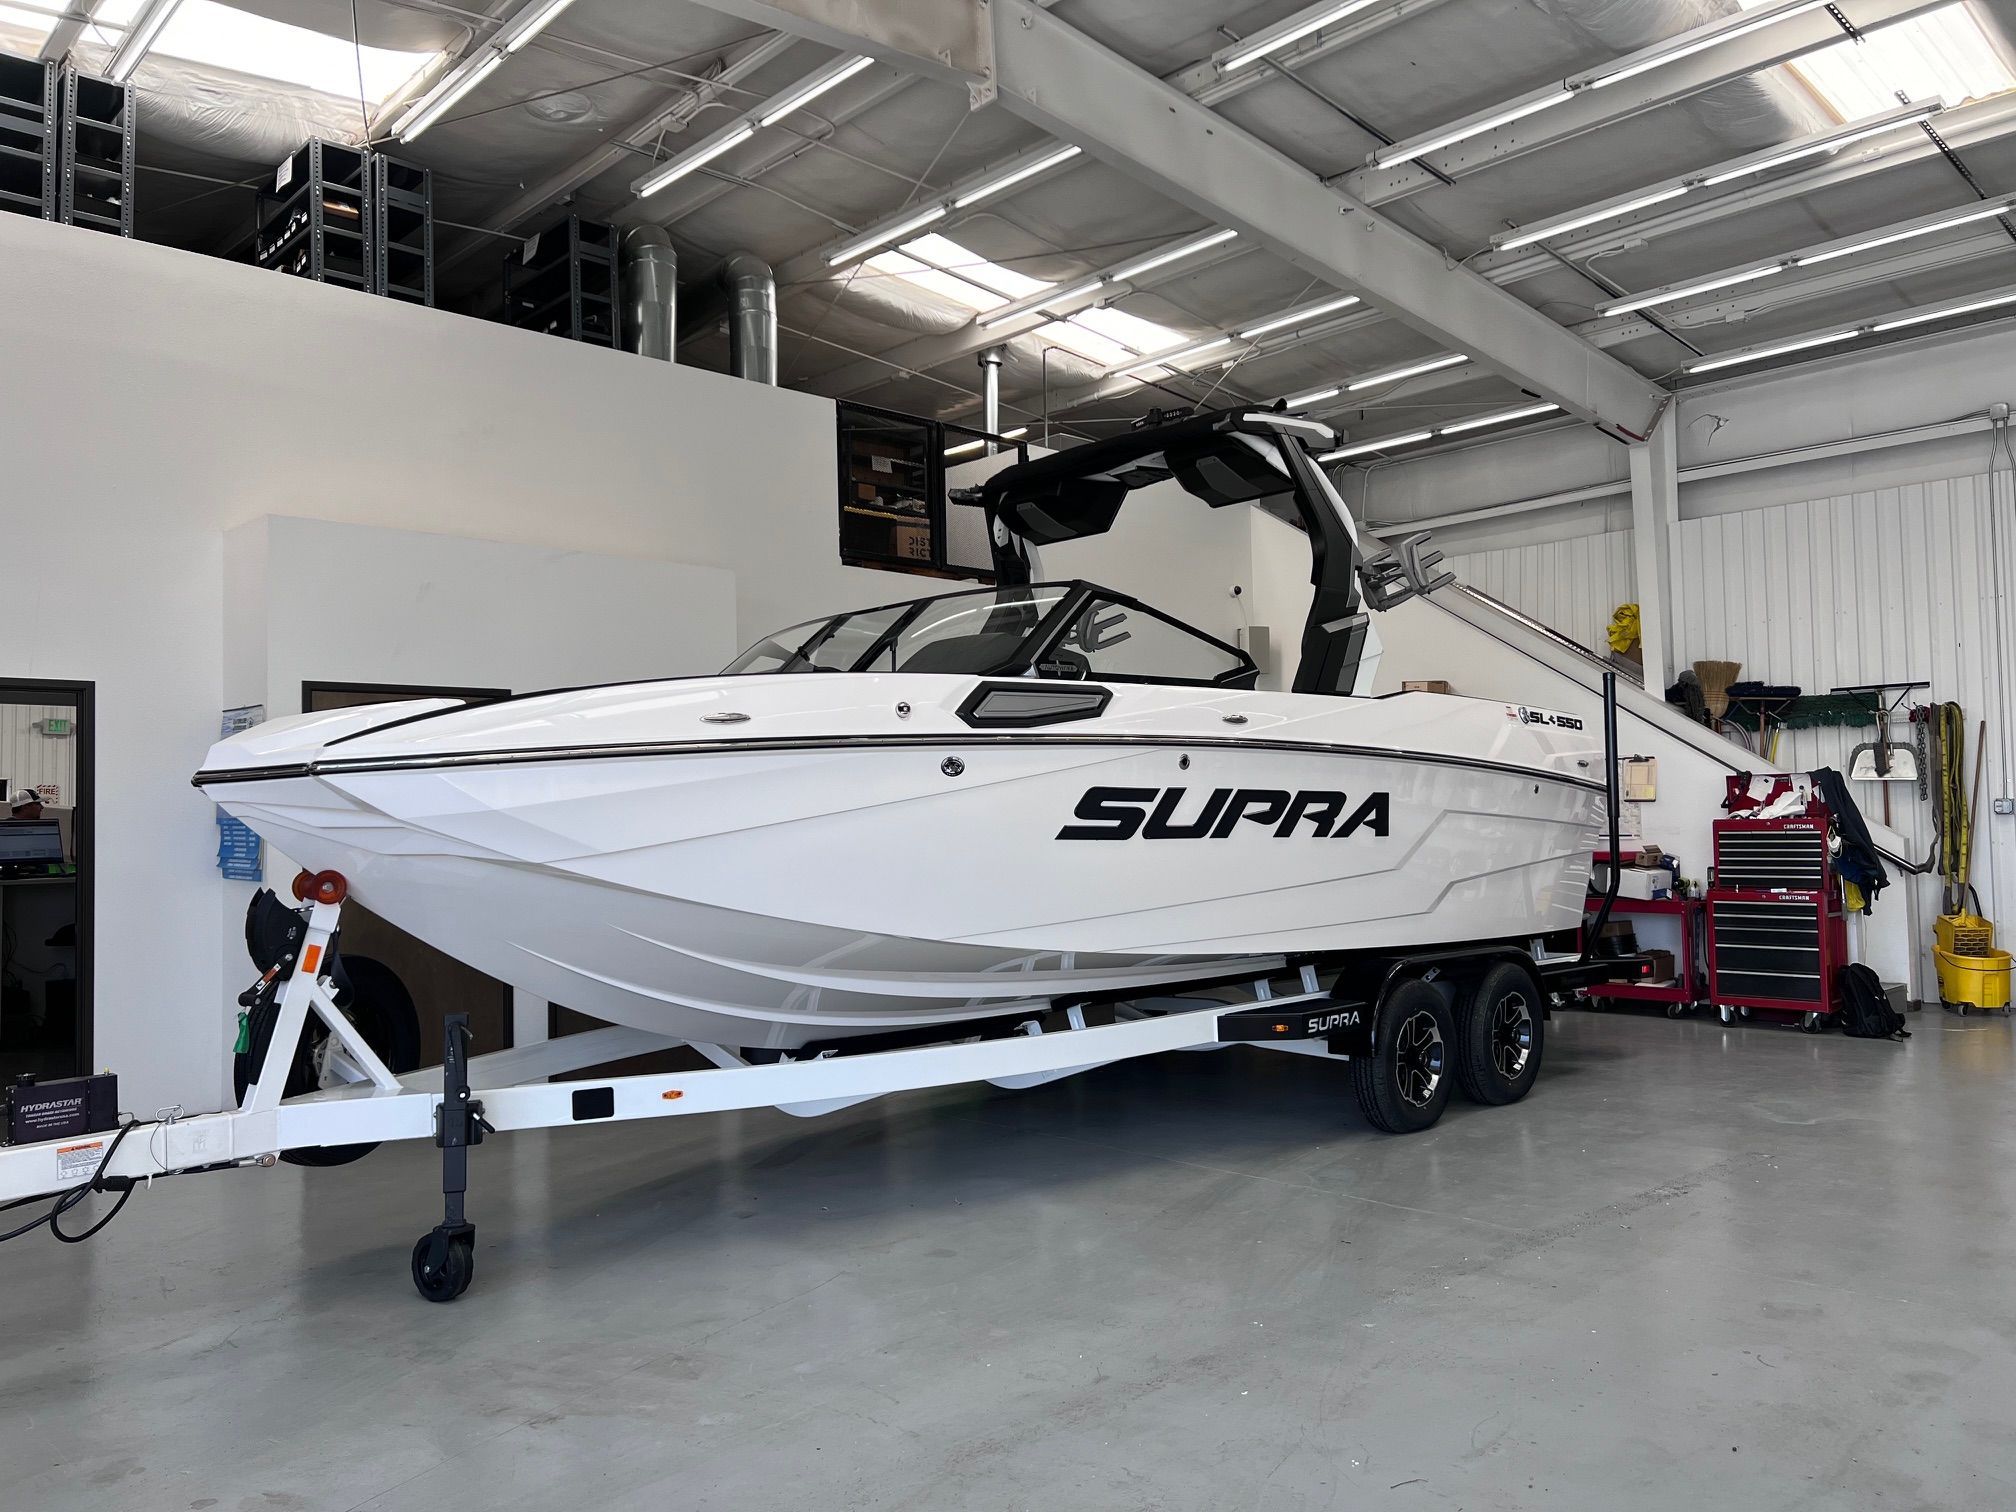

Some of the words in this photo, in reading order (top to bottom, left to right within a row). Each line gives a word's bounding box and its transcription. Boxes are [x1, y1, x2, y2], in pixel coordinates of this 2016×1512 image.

[48, 719, 68, 732] EXIT
[1054, 786, 1390, 841] SUPRA
[1308, 1011, 1360, 1033] SUPRA
[20, 1097, 82, 1113] HYDRASTAR
